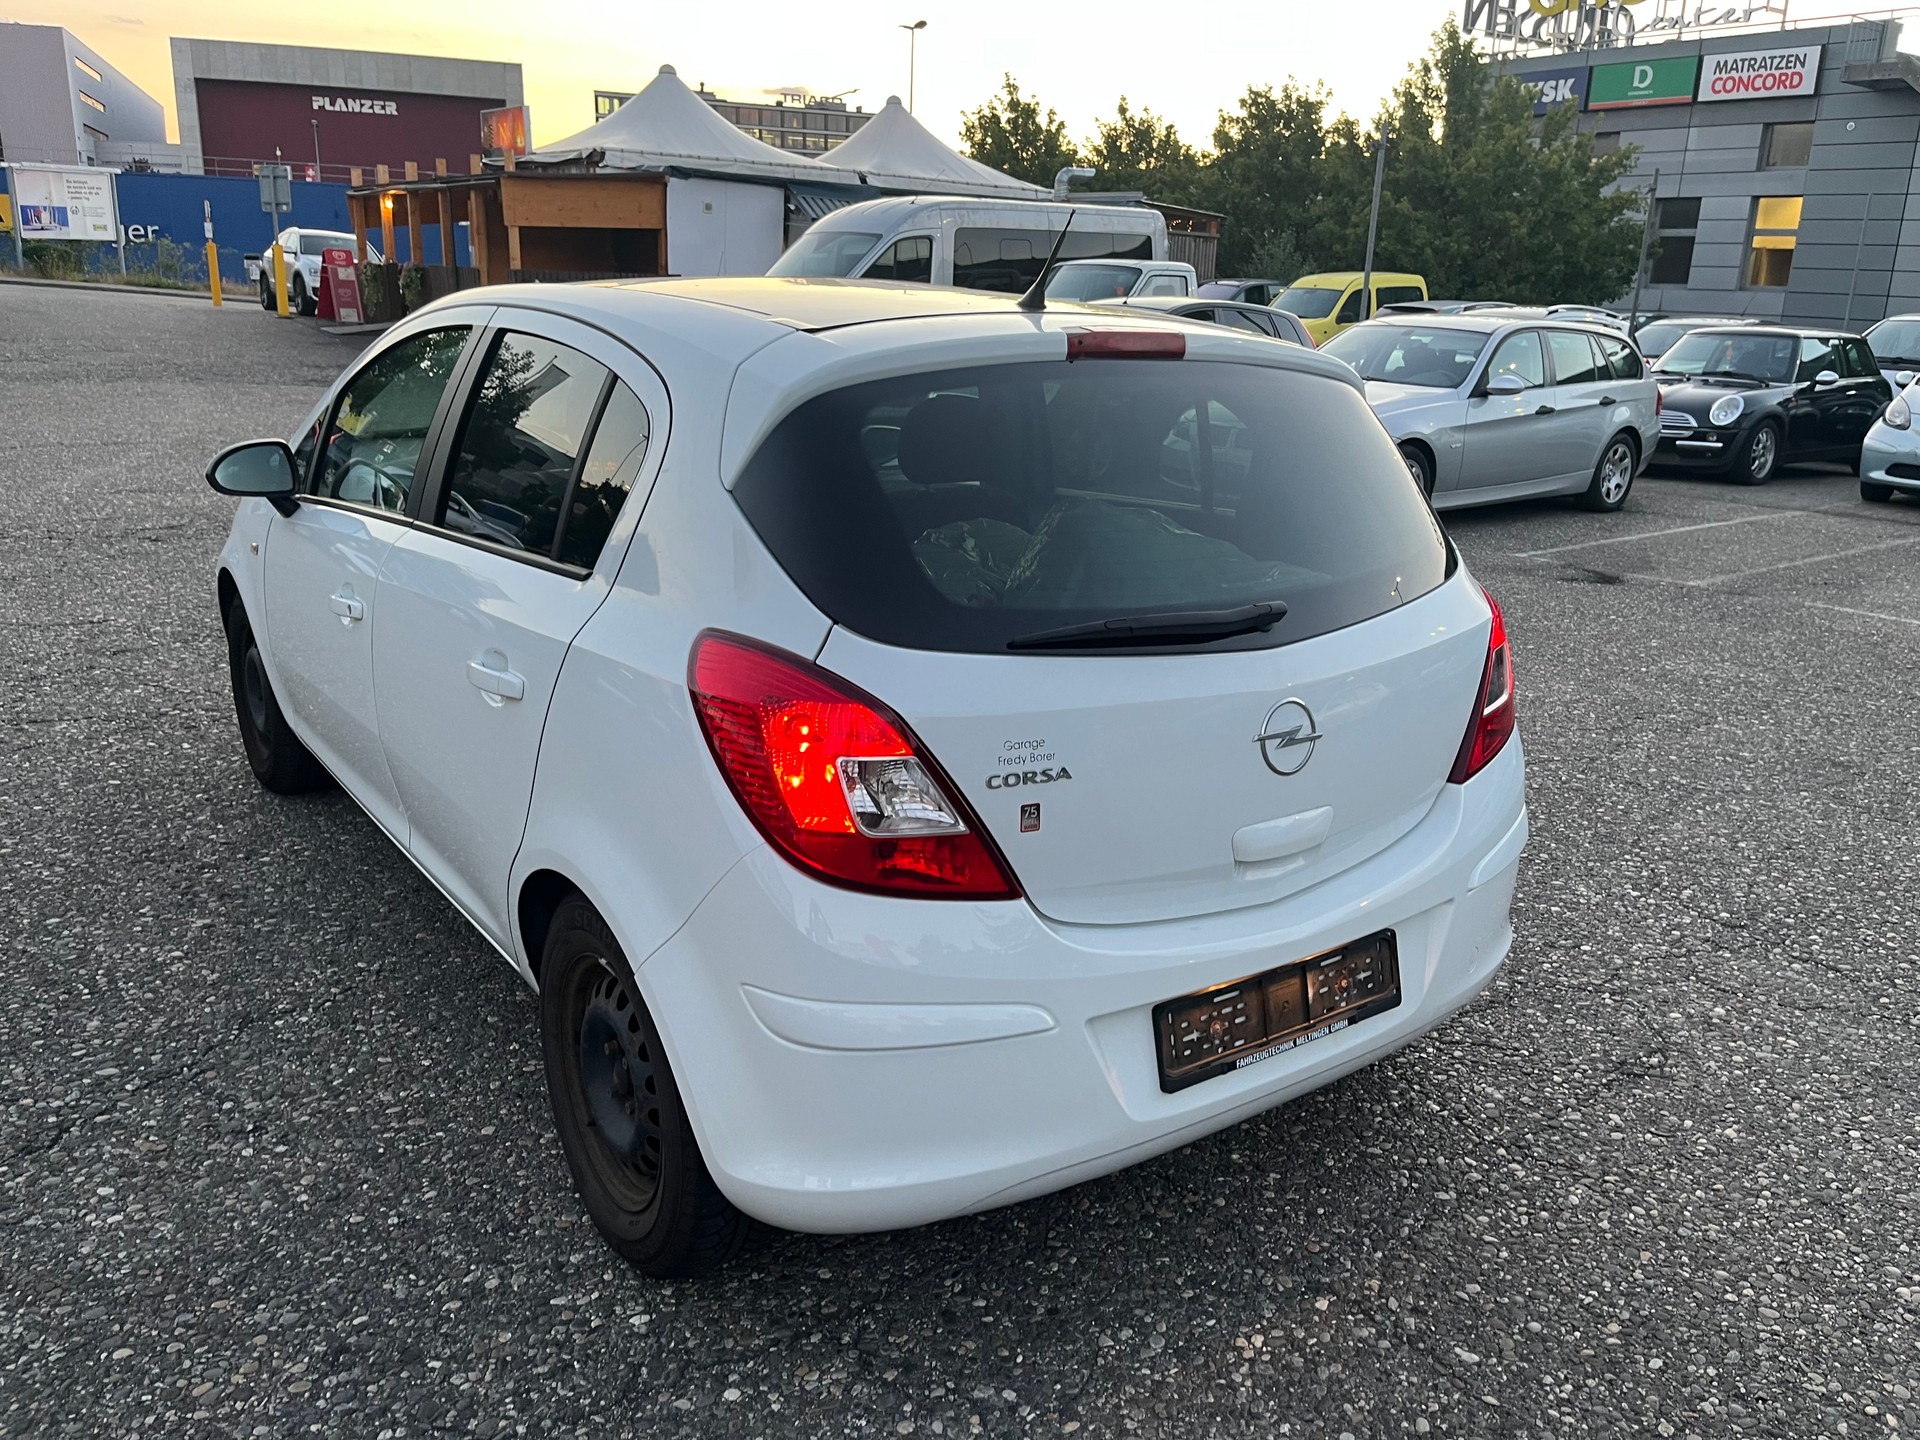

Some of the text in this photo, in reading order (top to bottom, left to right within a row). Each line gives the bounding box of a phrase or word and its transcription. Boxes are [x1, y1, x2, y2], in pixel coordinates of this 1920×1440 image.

[1713, 53, 1808, 75] MATRATZEN
[1632, 65, 1654, 89] D
[1711, 71, 1803, 95] CONCORD
[312, 95, 399, 115] PLANZER
[1003, 739, 1045, 751] Garage
[997, 752, 1056, 766] Fredy Borer
[985, 766, 1072, 790] CORSA
[1024, 805, 1038, 819] 75
[1236, 1019, 1349, 1069] FAHRZEUGTECHNIK MELTINGEN GMBH
